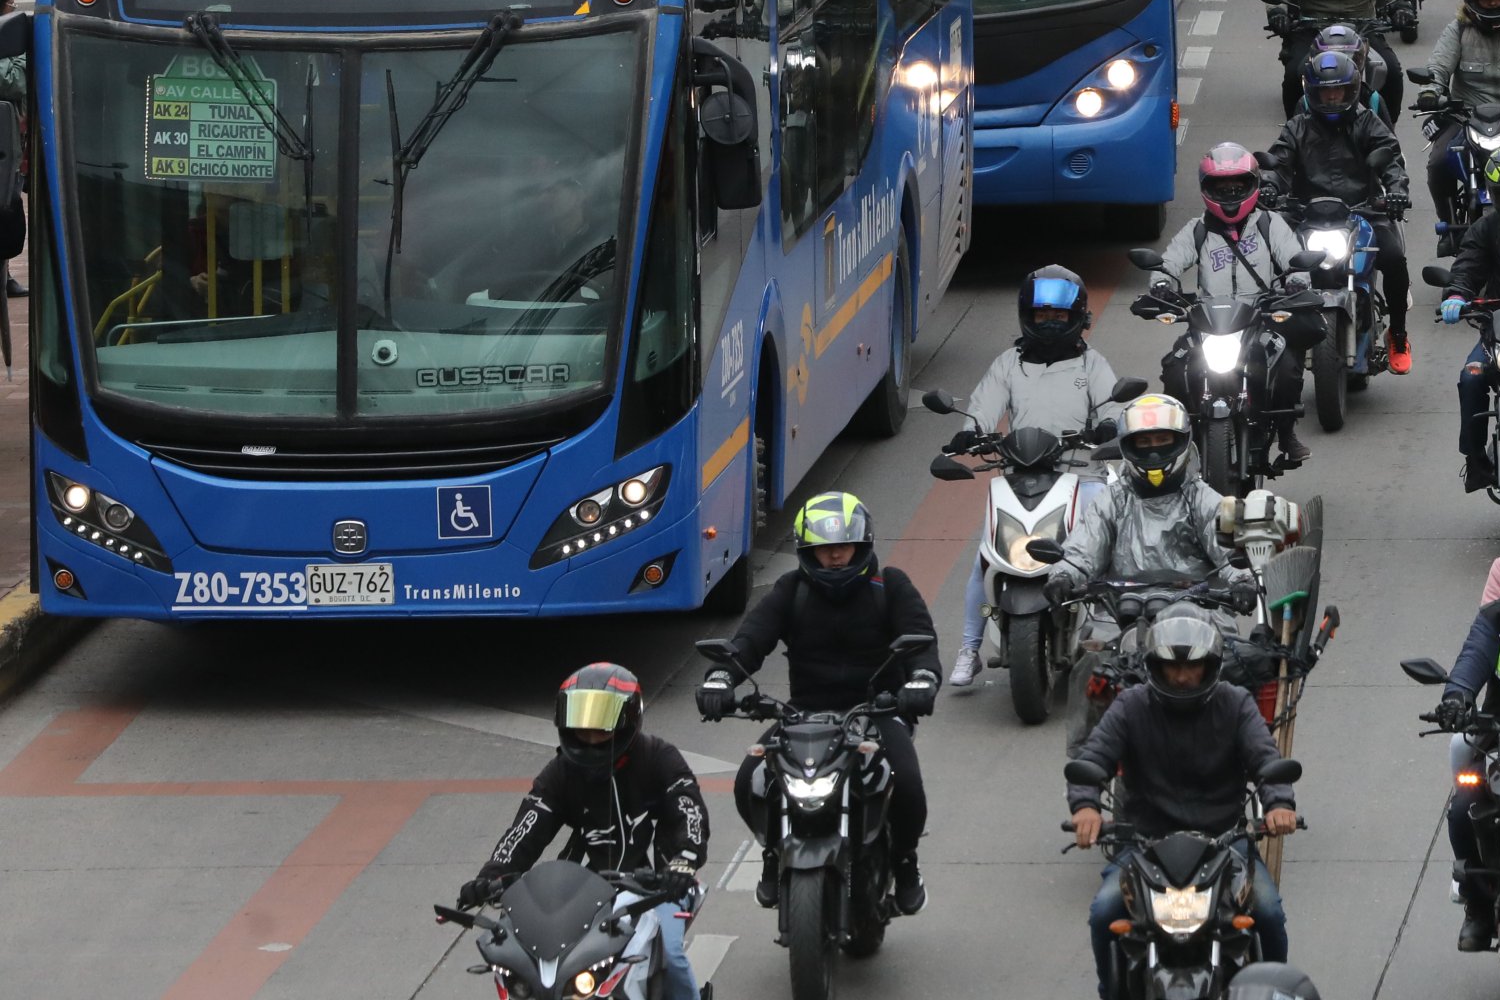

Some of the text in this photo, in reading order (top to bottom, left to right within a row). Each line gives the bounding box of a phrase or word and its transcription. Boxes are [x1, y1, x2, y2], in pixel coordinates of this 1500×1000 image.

[165, 86, 186, 98] AV
[190, 86, 242, 100] CALLE
[154, 104, 188, 117] AK 24
[209, 105, 255, 120] TUNAL
[153, 132, 188, 145] AK 30
[198, 124, 266, 139] RICAURTE
[197, 143, 266, 159] EL CAMPÍN
[155, 160, 186, 173] AK 9
[190, 161, 273, 177] CHICÓ NORTE
[837, 177, 895, 285] TransMilenio
[416, 364, 571, 388] BUSSCAR
[174, 571, 307, 604] Z80-7353
[404, 584, 522, 600] TransMilenio
